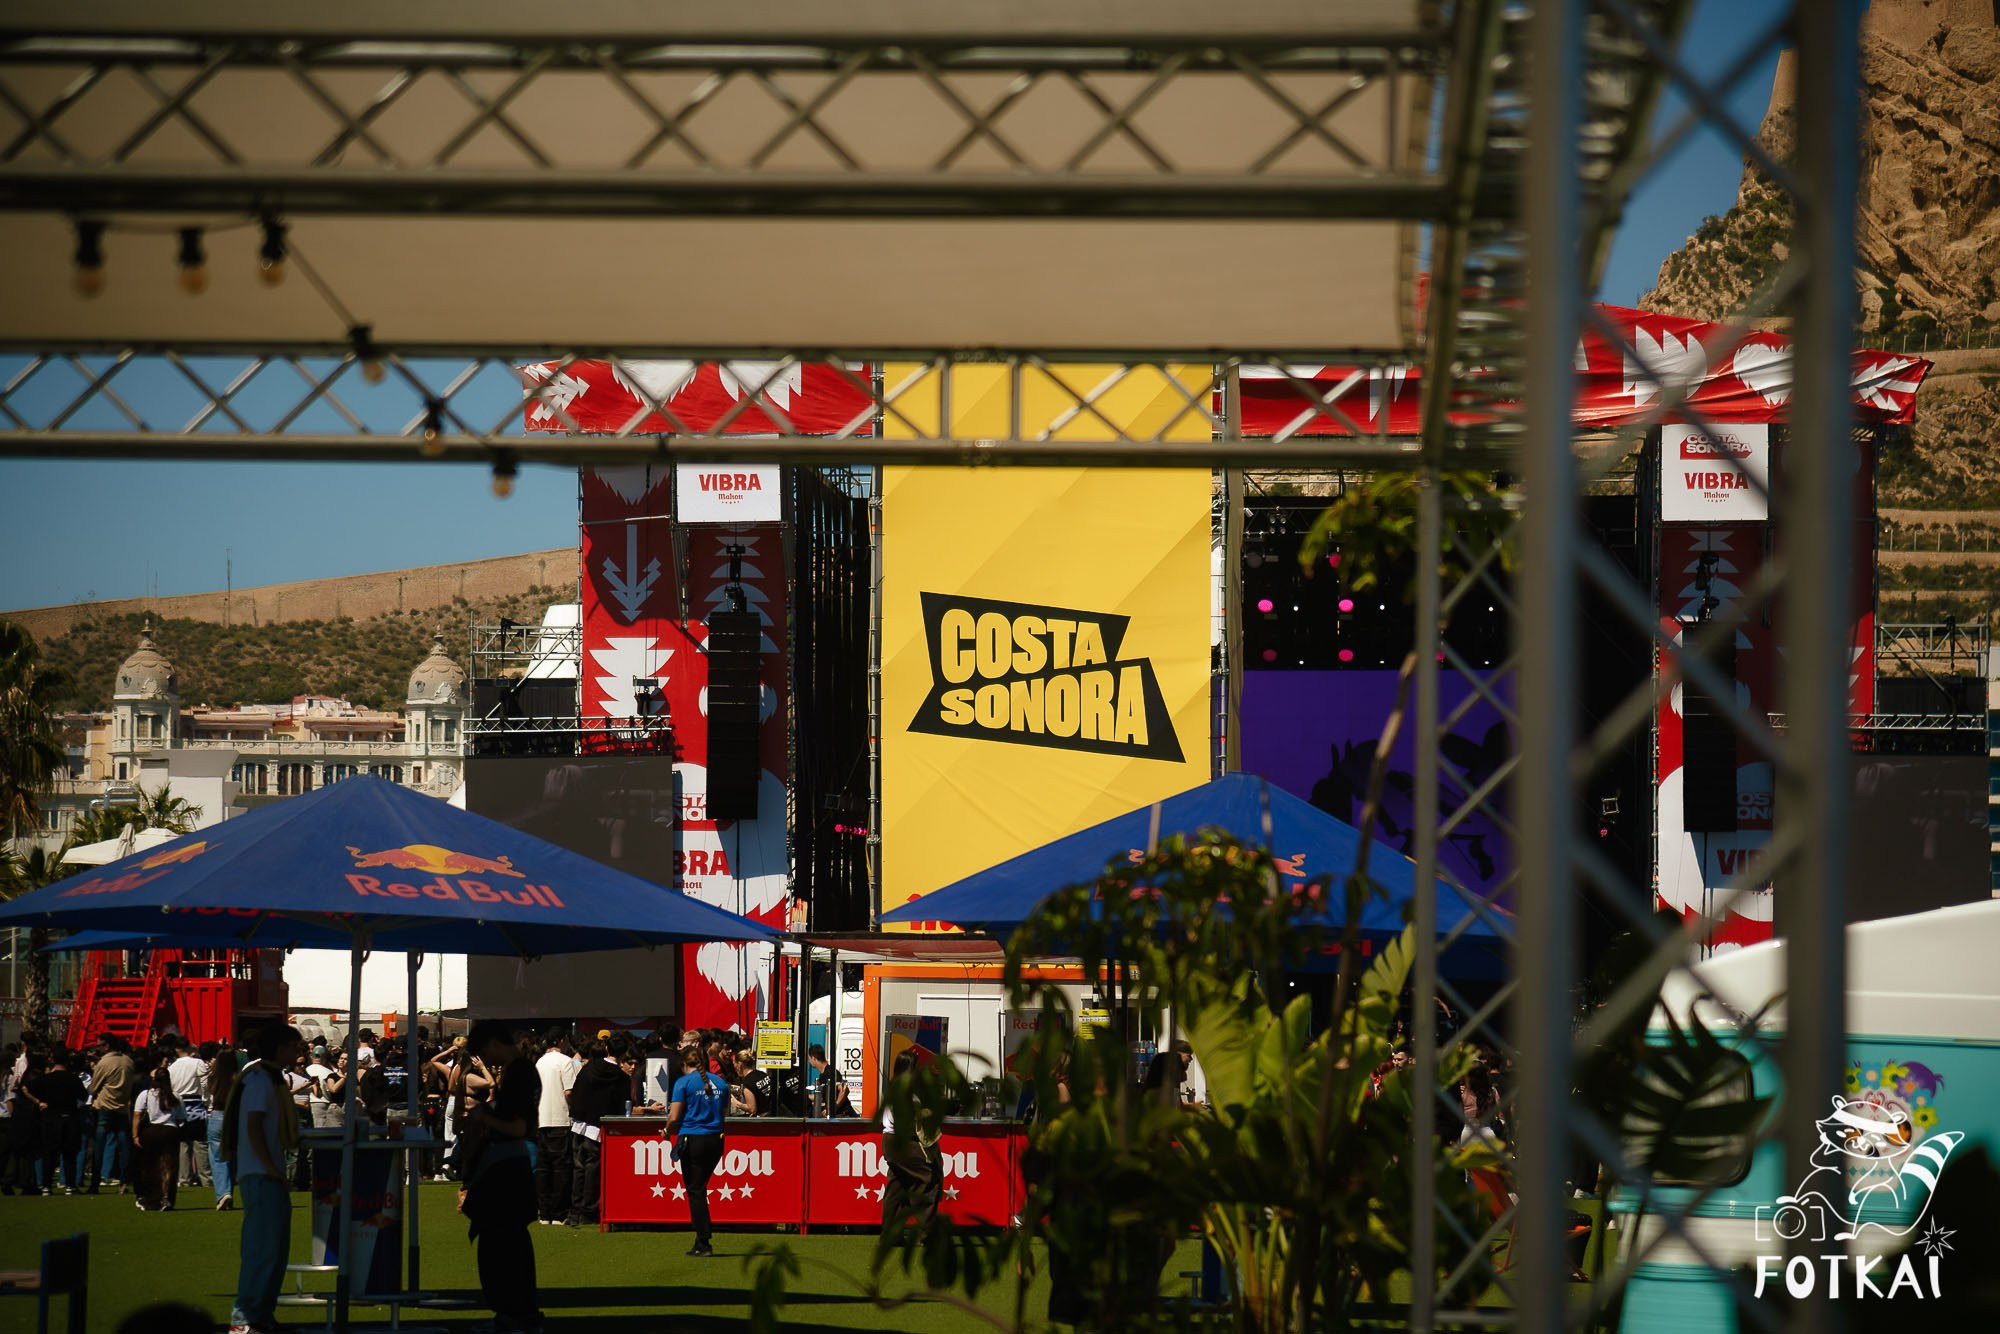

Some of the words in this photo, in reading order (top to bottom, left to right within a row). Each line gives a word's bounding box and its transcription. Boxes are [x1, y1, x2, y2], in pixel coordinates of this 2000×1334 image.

[699, 473, 762, 491] VIBRA
[1684, 472, 1749, 490] VIBRA
[1704, 491, 1730, 499] Mahou
[941, 609, 1107, 684] COSTA
[940, 665, 1149, 746] SONORA
[673, 850, 731, 876] BRA
[345, 874, 460, 900] Red
[457, 879, 565, 908] Bull
[785, 1075, 800, 1088] STA
[631, 1139, 775, 1176] Mou
[835, 1141, 980, 1178] Mou
